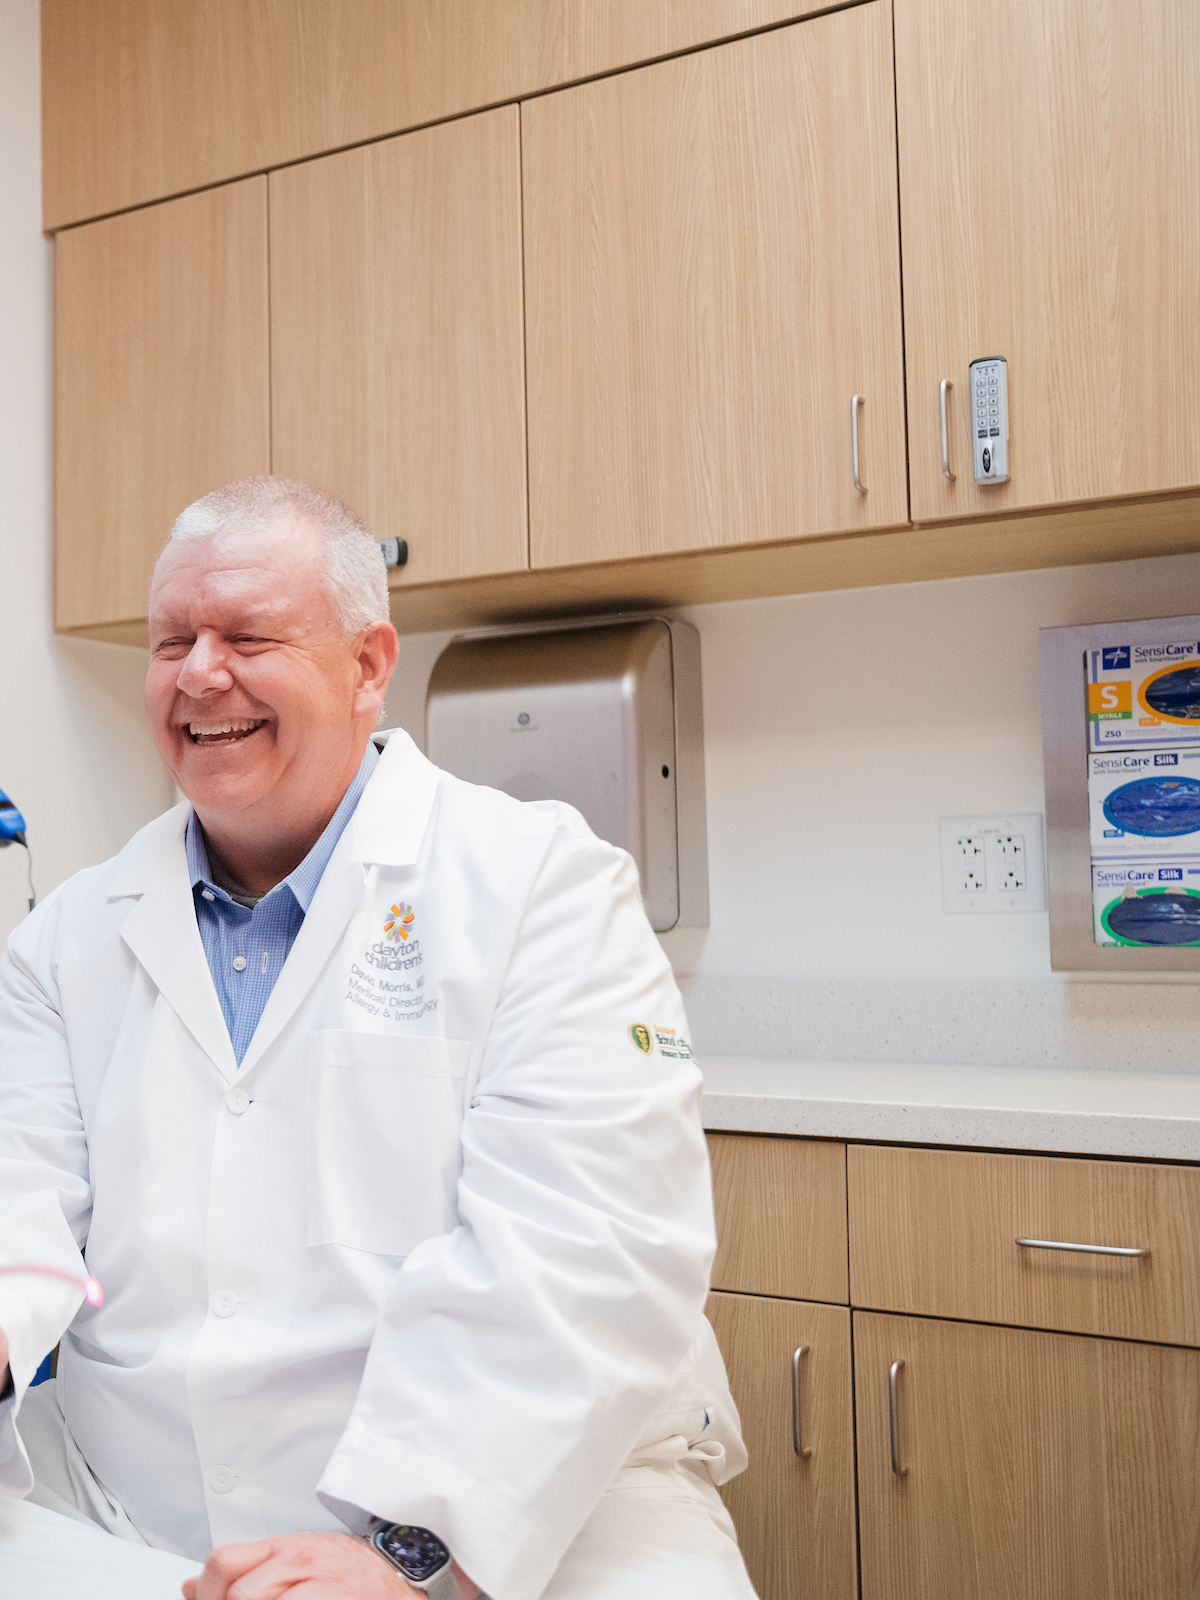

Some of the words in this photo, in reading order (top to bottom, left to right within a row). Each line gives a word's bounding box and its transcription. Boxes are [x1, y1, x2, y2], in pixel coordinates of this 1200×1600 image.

[1134, 644, 1194, 661] SensiCare
[1101, 686, 1119, 709] S
[1104, 730, 1122, 738] 250
[1093, 756, 1150, 769] SensiCare
[1155, 754, 1176, 765] Silk
[1097, 869, 1155, 881] SensiCare
[1159, 869, 1180, 880] Silk
[372, 940, 419, 959] dayton
[351, 963, 375, 986] David
[348, 977, 386, 1005] Medical
[344, 991, 380, 1016] Allergy
[382, 1008, 391, 1019] &
